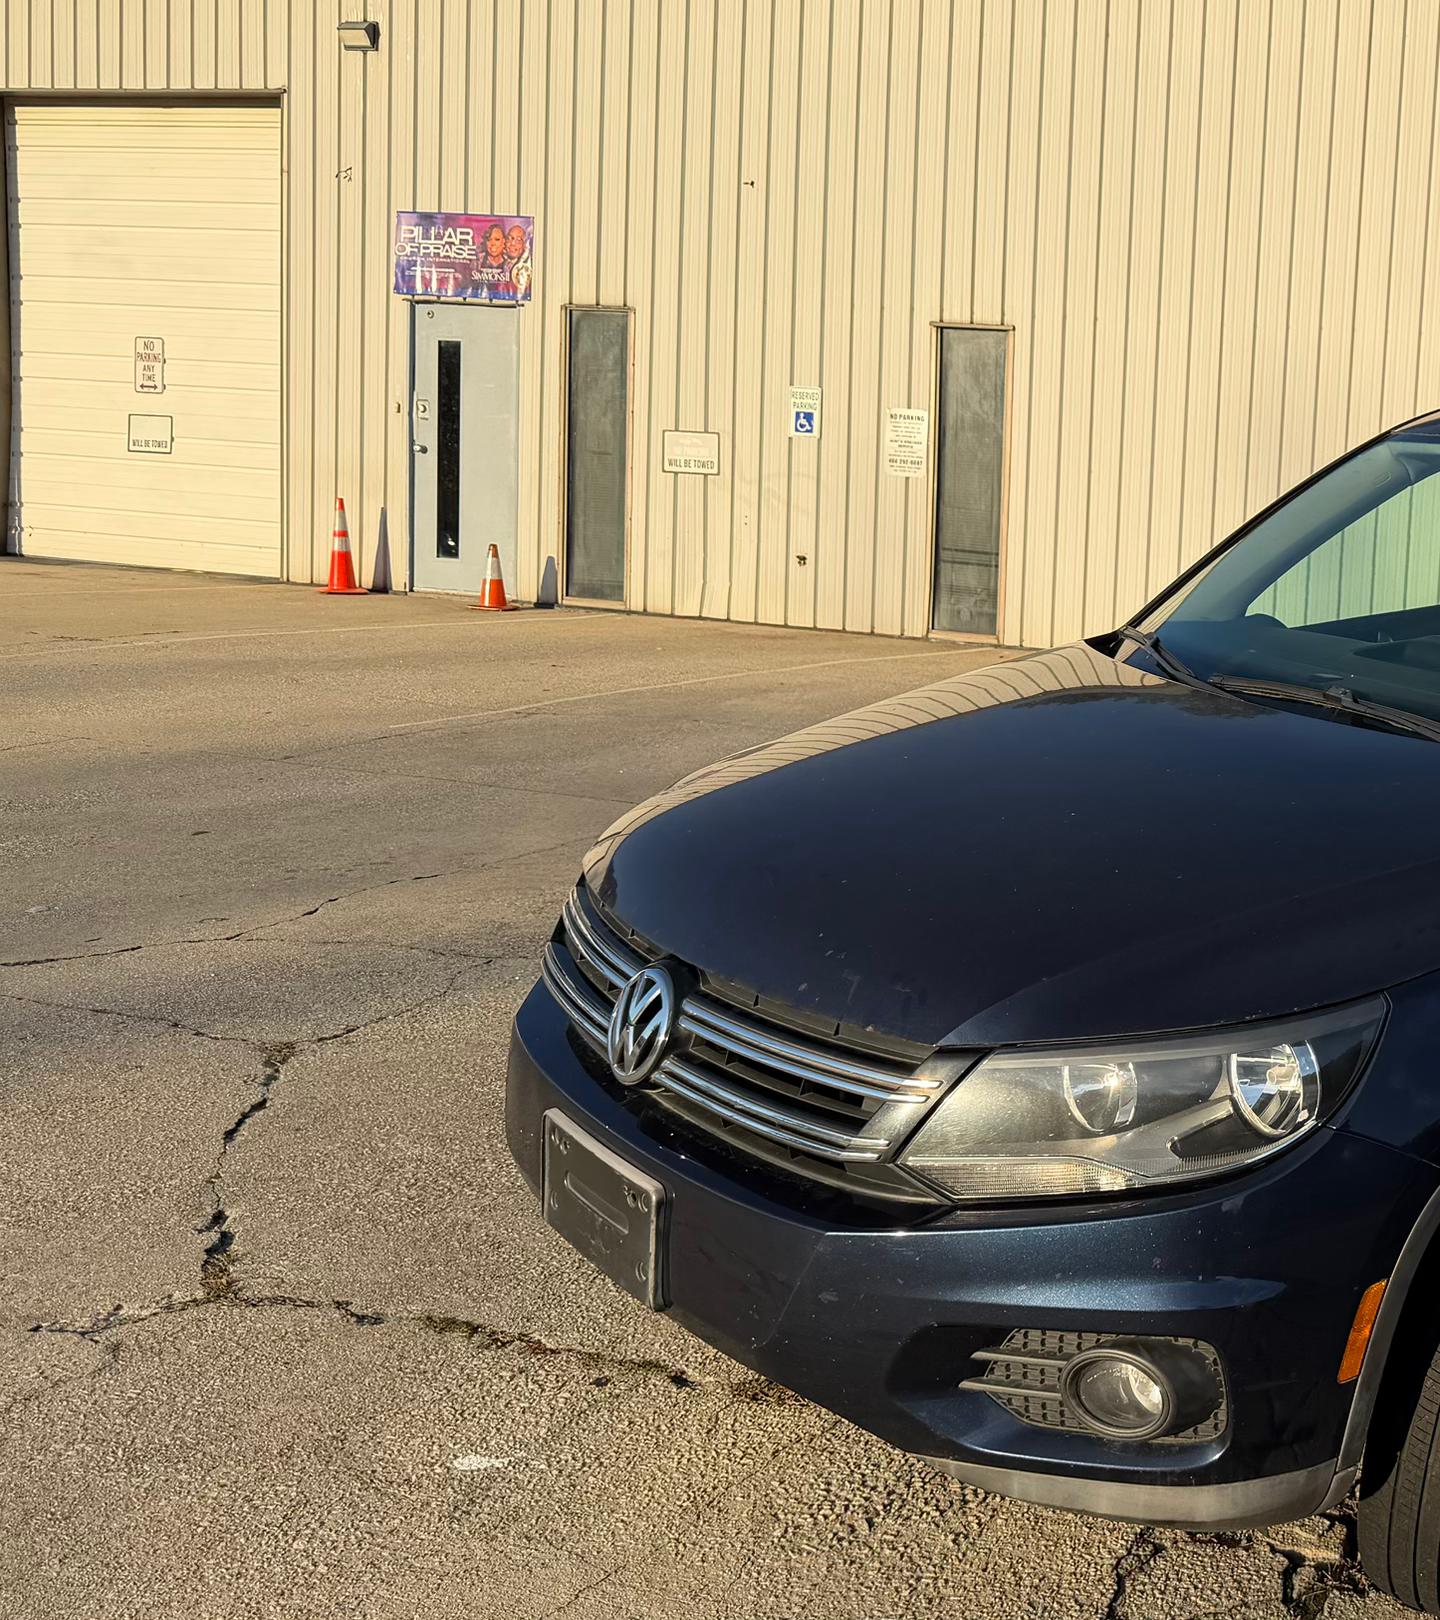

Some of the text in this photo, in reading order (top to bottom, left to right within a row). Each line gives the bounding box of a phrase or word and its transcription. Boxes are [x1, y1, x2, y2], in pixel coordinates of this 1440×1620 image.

[400, 225, 474, 246] PILLAR
[395, 242, 477, 260] OF PRAISE
[143, 340, 155, 352] NO
[136, 352, 161, 363] PARKING
[142, 364, 155, 373] ANY
[142, 373, 156, 382] TIME
[791, 391, 819, 401] RESERVED
[792, 401, 817, 411] PARKING
[898, 413, 925, 422] PARKING
[132, 438, 168, 449] WILL BE TOWED
[667, 458, 715, 470] WILL BE TOWED
